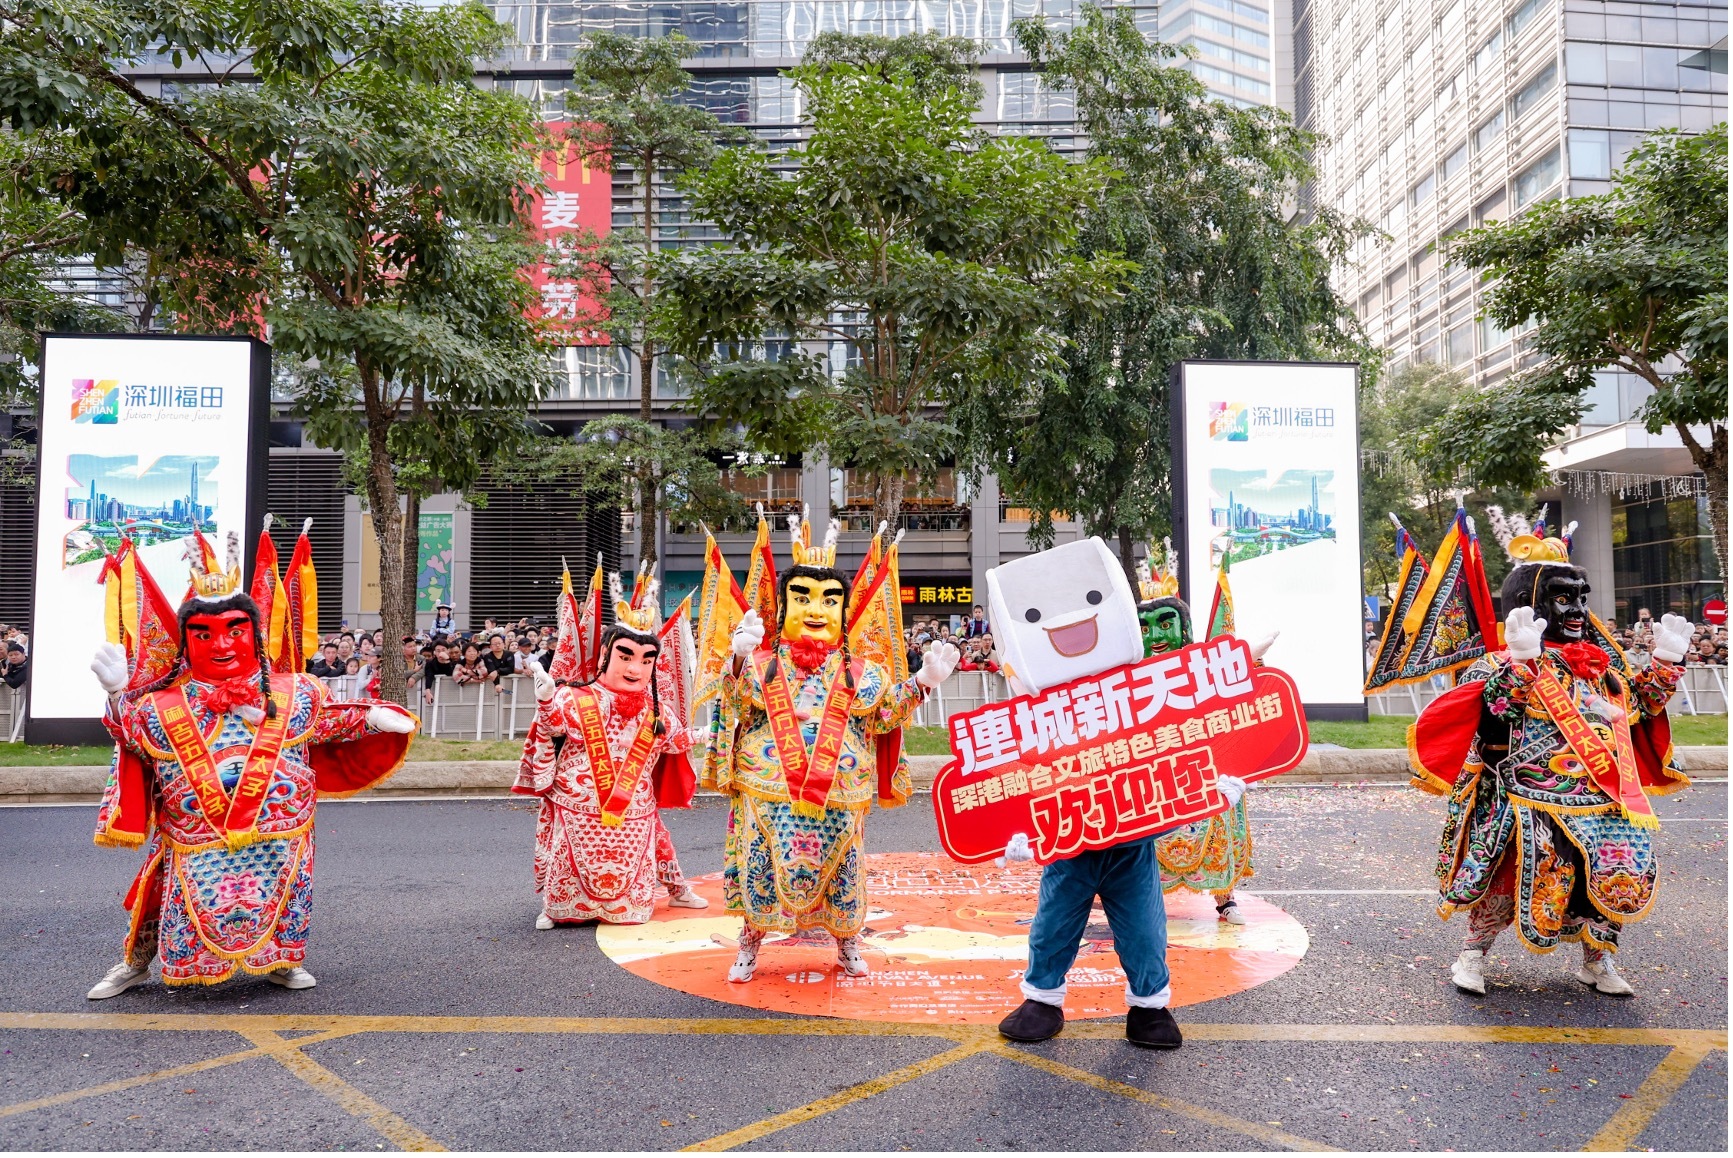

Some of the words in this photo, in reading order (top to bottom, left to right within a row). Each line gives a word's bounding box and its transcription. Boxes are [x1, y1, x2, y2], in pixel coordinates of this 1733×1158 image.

[79, 388, 105, 398] SHEN
[79, 398, 105, 406] ZHEN
[124, 385, 223, 408] 深圳福田
[78, 406, 114, 415] FUTIAN
[123, 409, 152, 421] futian
[155, 409, 190, 421] fortune
[191, 409, 222, 422] future
[1252, 406, 1334, 427] 深圳福田
[1215, 425, 1245, 433] FUTIAN
[919, 586, 973, 603] 雨林古
[955, 639, 1254, 776] 連城新天地
[1537, 677, 1611, 776] 吉五方太子
[577, 695, 614, 791] 麻吉五方太子
[950, 692, 1284, 815] 深港融合文旅特色美食商业街
[163, 704, 226, 818] 麻吉五方太子
[1030, 746, 1225, 860] 欢迎您
